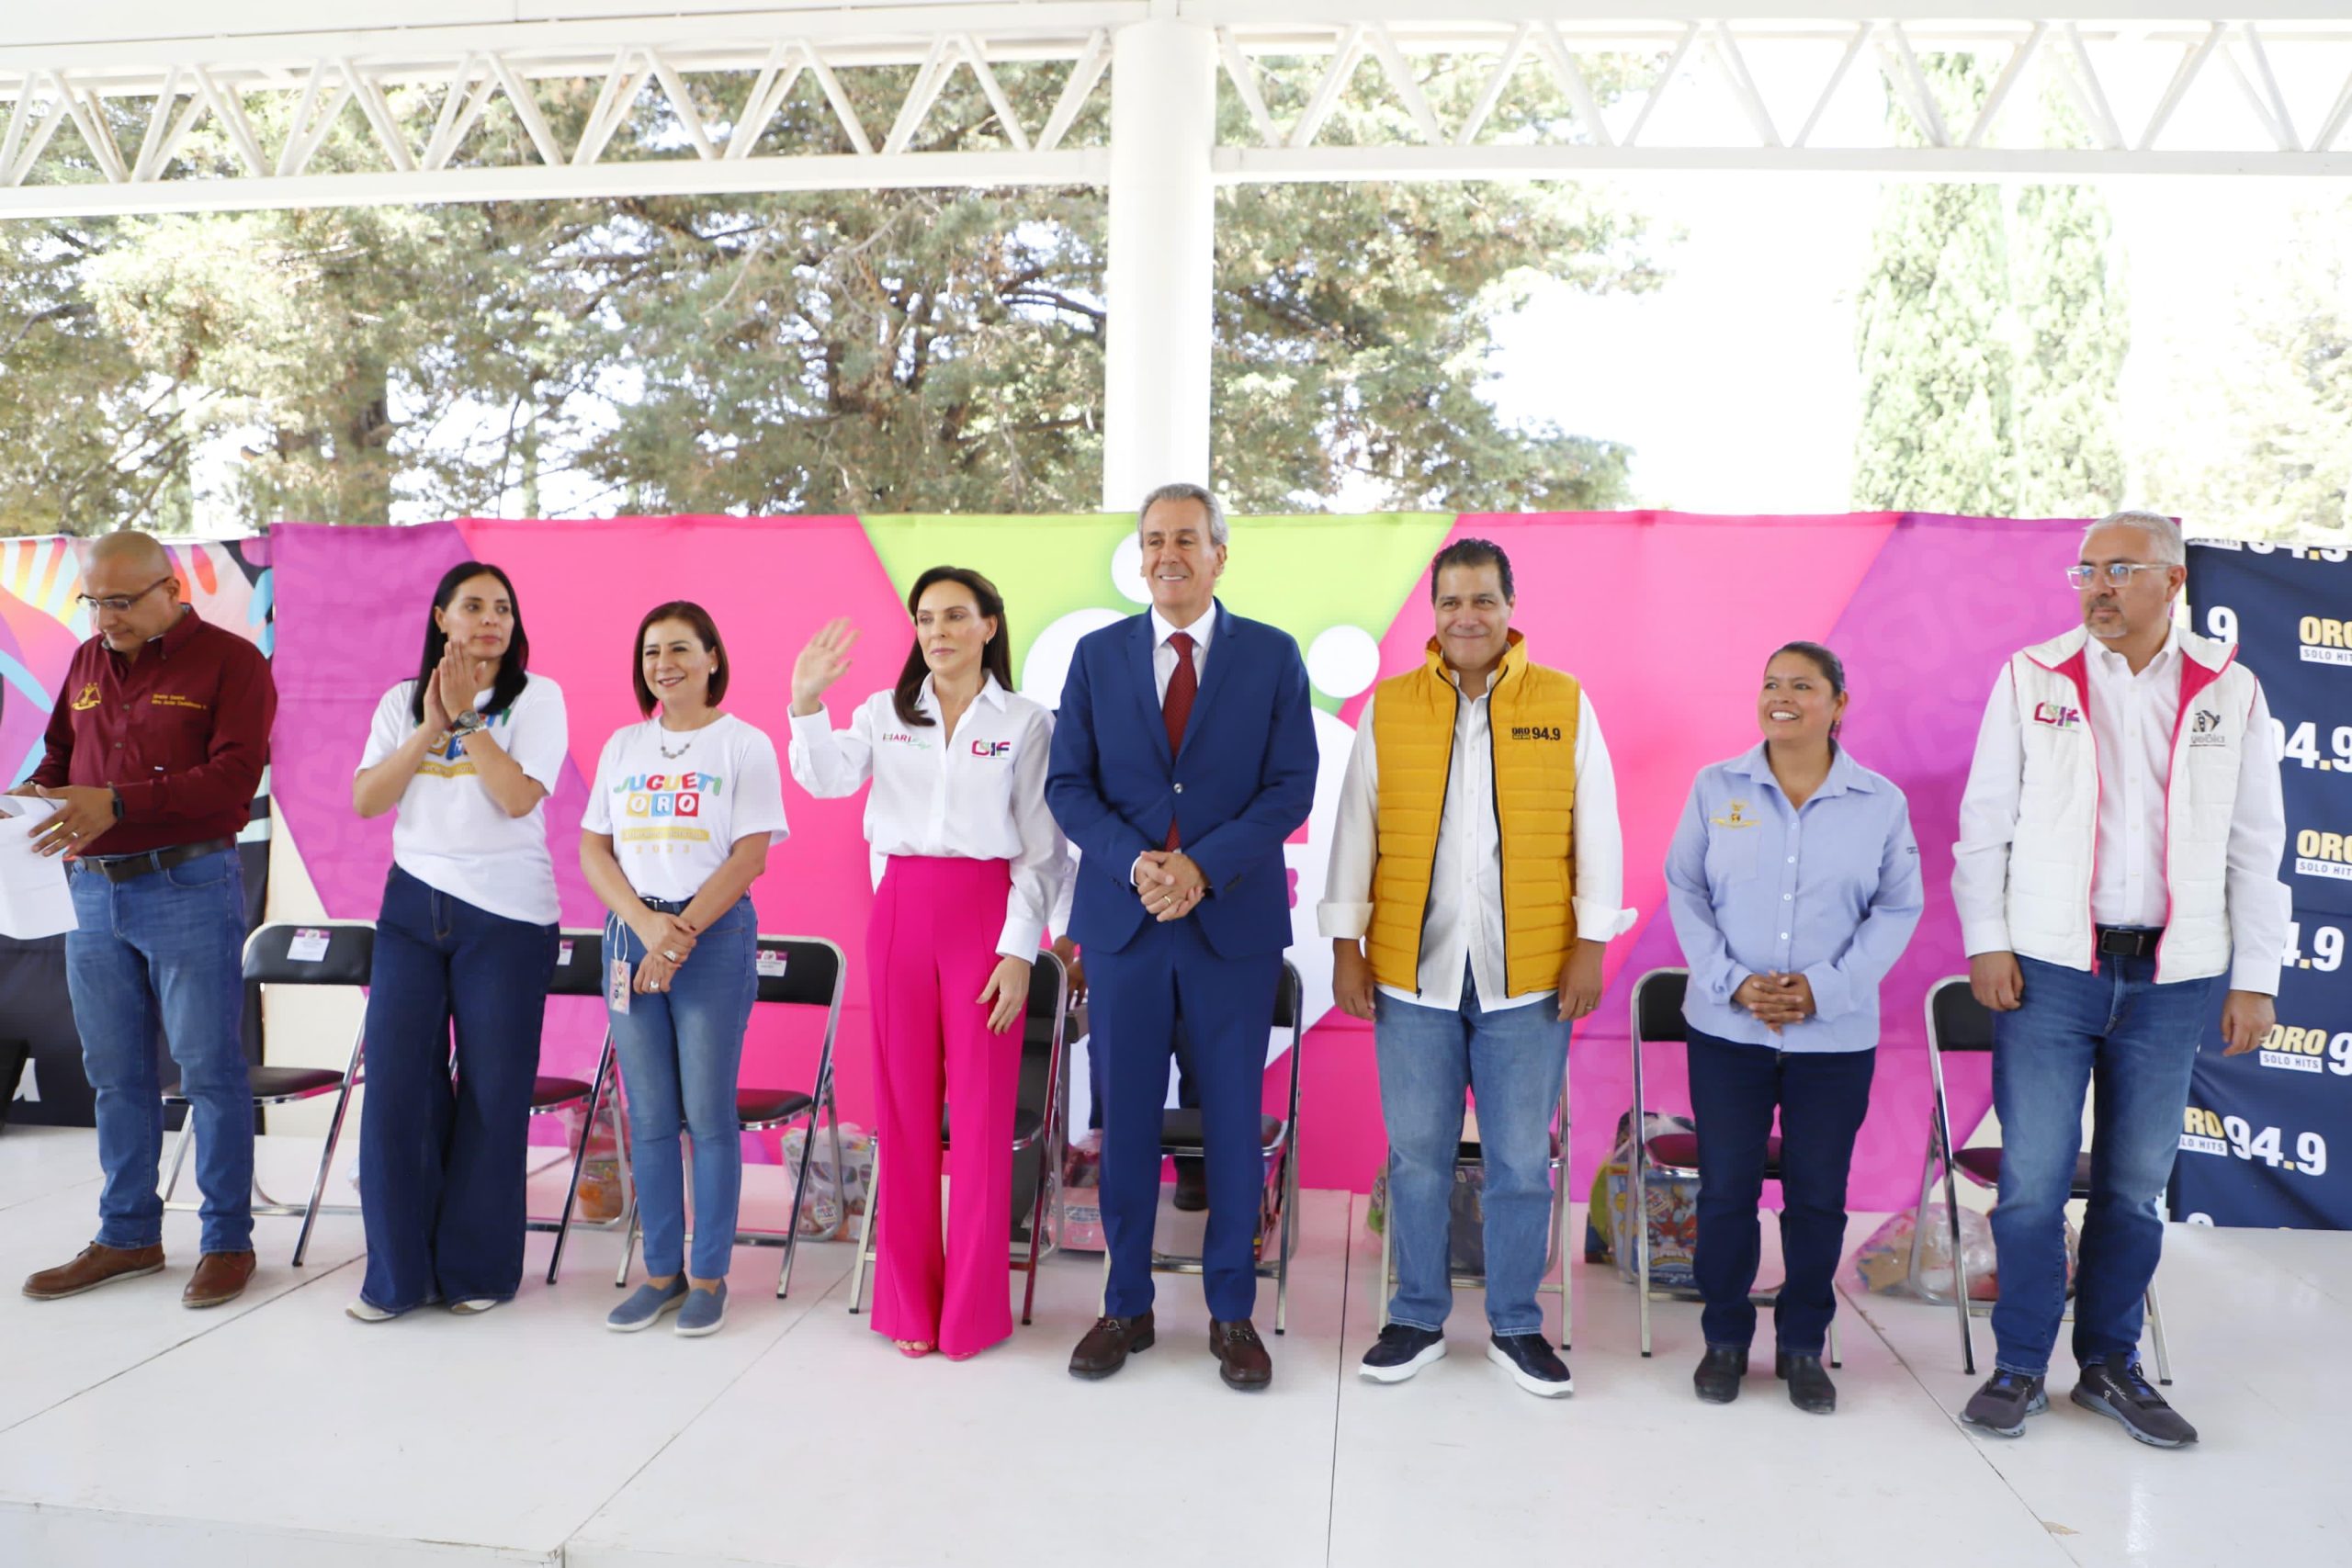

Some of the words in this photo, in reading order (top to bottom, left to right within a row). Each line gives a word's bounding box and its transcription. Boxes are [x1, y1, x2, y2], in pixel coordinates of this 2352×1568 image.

[2303, 649, 2333, 660] SOLO
[1532, 727, 1561, 740] 94.9
[629, 794, 697, 814] ORO
[2300, 862, 2328, 873] SOLO
[2260, 1023, 2327, 1055] ORO
[2263, 1054, 2290, 1066] SOLO
[2295, 1057, 2319, 1069] HITS
[2183, 1106, 2225, 1138] RO
[2222, 1115, 2327, 1176] 94.9
[2199, 1139, 2224, 1152] HITS
